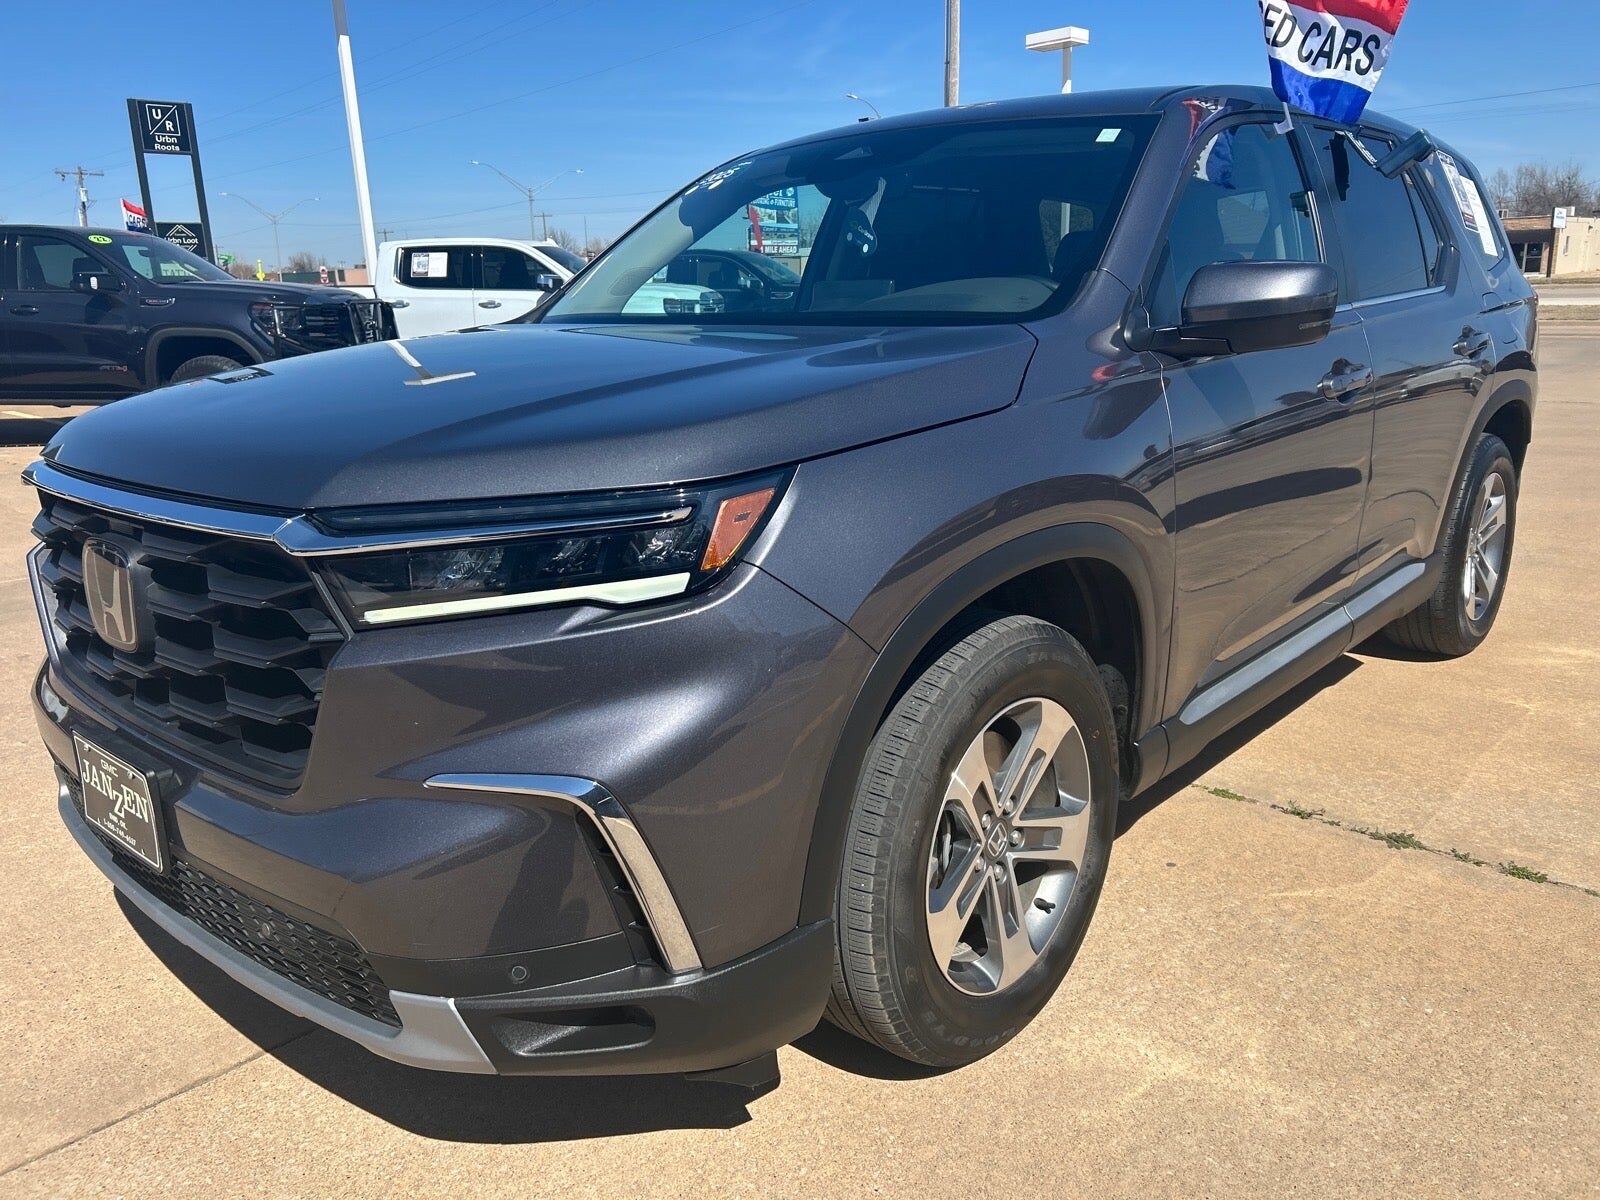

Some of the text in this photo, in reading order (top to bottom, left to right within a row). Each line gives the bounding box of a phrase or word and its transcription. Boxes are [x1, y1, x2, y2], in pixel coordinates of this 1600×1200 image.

[1260, 3, 1381, 76] ED CARS
[152, 108, 162, 120] U
[165, 120, 175, 132] R
[155, 134, 178, 144] Urbn
[154, 143, 180, 151] Roots
[764, 245, 778, 254] MILE
[778, 246, 797, 254] AHEAD
[100, 759, 119, 778] GMC
[82, 758, 150, 824] JANZEN
